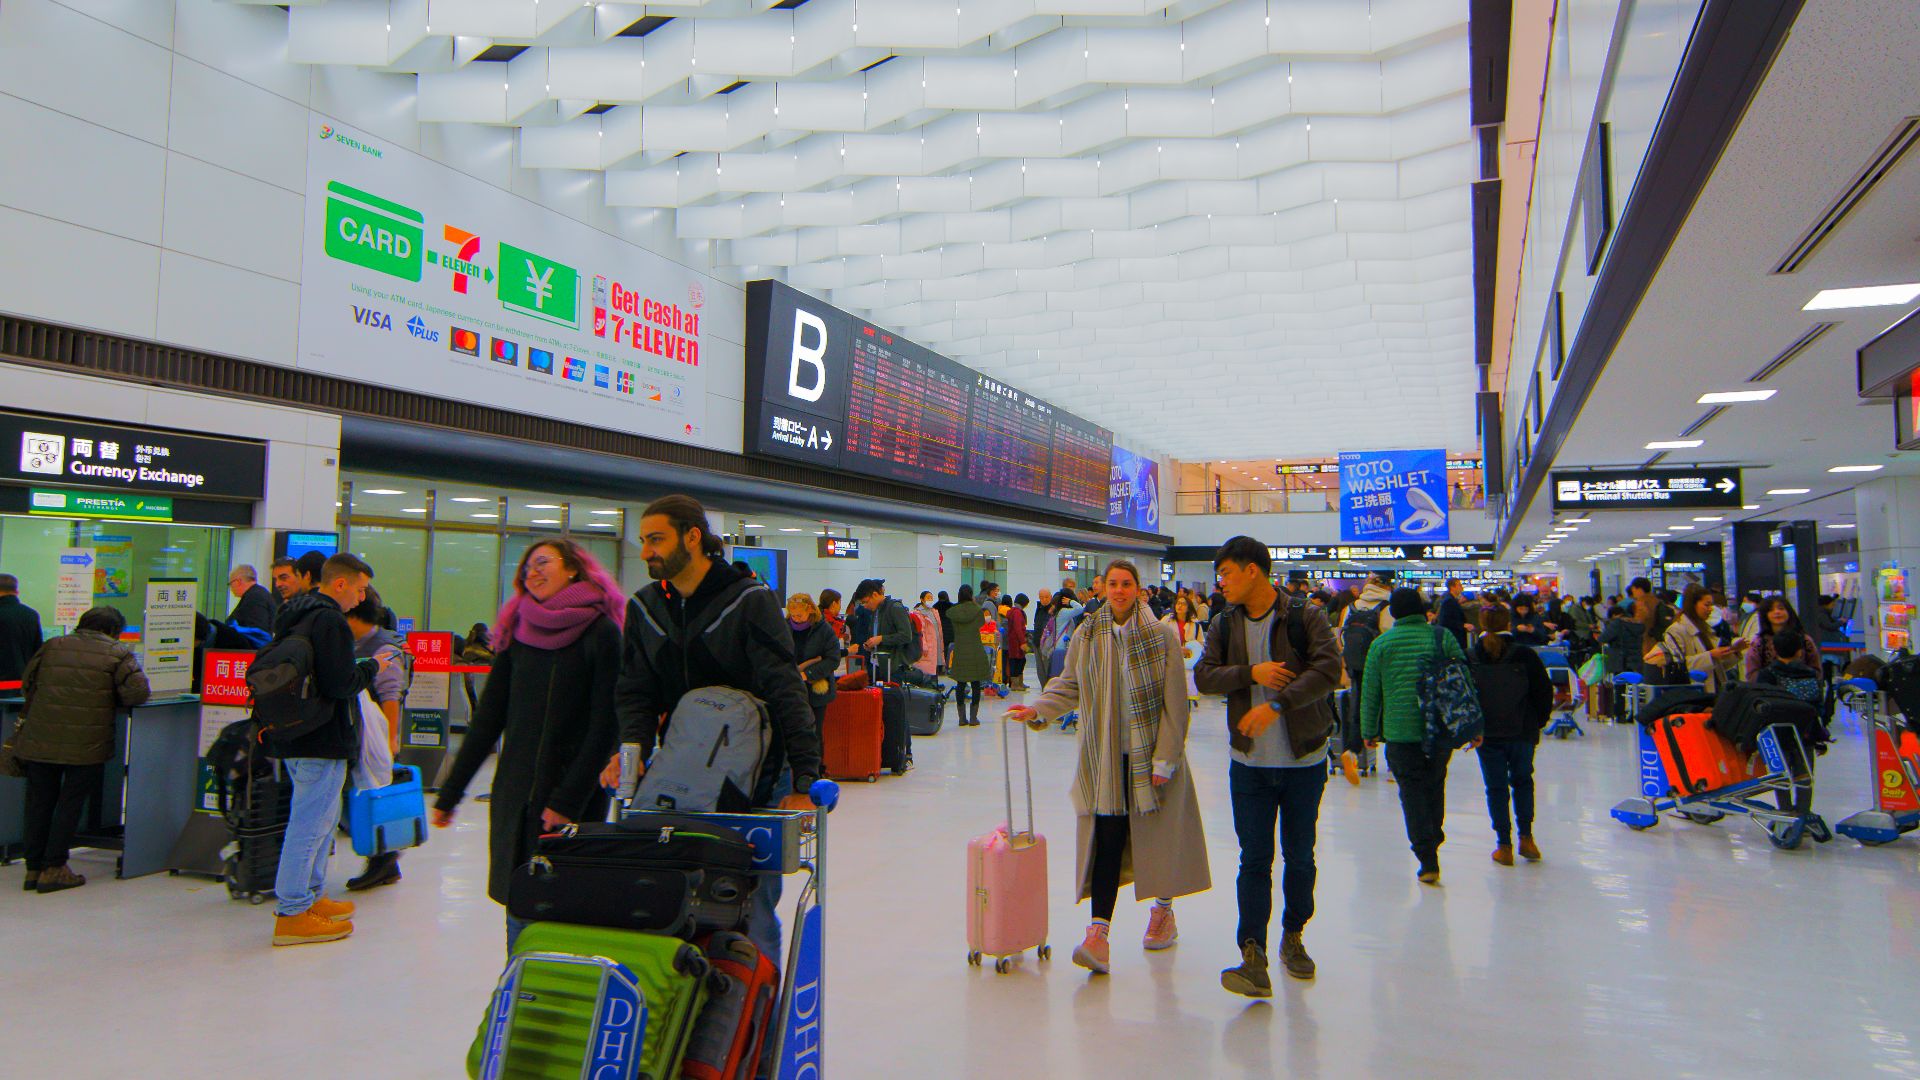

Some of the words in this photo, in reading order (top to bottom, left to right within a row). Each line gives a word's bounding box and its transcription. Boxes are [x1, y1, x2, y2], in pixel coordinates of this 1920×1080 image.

[336, 134, 361, 151] SEVEN
[361, 144, 384, 159] BANK
[339, 216, 412, 260] CARD
[351, 282, 372, 297] Using
[391, 293, 406, 305] ATM
[350, 304, 393, 332] VISA
[611, 281, 640, 317] Get
[643, 297, 682, 331] cash
[684, 312, 700, 337] at
[415, 326, 439, 343] PLUS
[788, 308, 828, 402] B
[616, 376, 635, 388] JCB
[773, 416, 808, 434] 到着ロビー
[772, 430, 789, 443] Arrival
[789, 434, 805, 448] Lobby
[807, 425, 818, 450] A
[72, 438, 119, 460] 両替
[70, 460, 138, 483] Currency
[138, 466, 205, 488] Exchange
[1345, 459, 1393, 478] TOTO
[1584, 491, 1621, 500] Terminal
[1621, 490, 1653, 500] Shuttle
[1653, 490, 1670, 499] Bus
[1360, 507, 1395, 530] No.1
[1394, 546, 1406, 559] A
[157, 589, 188, 602] 両替
[417, 639, 442, 653] 両替
[216, 660, 248, 679] 両替
[413, 656, 449, 666] XCHANGE
[205, 683, 250, 698] EXCHANG
[1761, 737, 1782, 769] DHC
[1641, 749, 1660, 796] DHC
[1882, 787, 1907, 797] Daily
